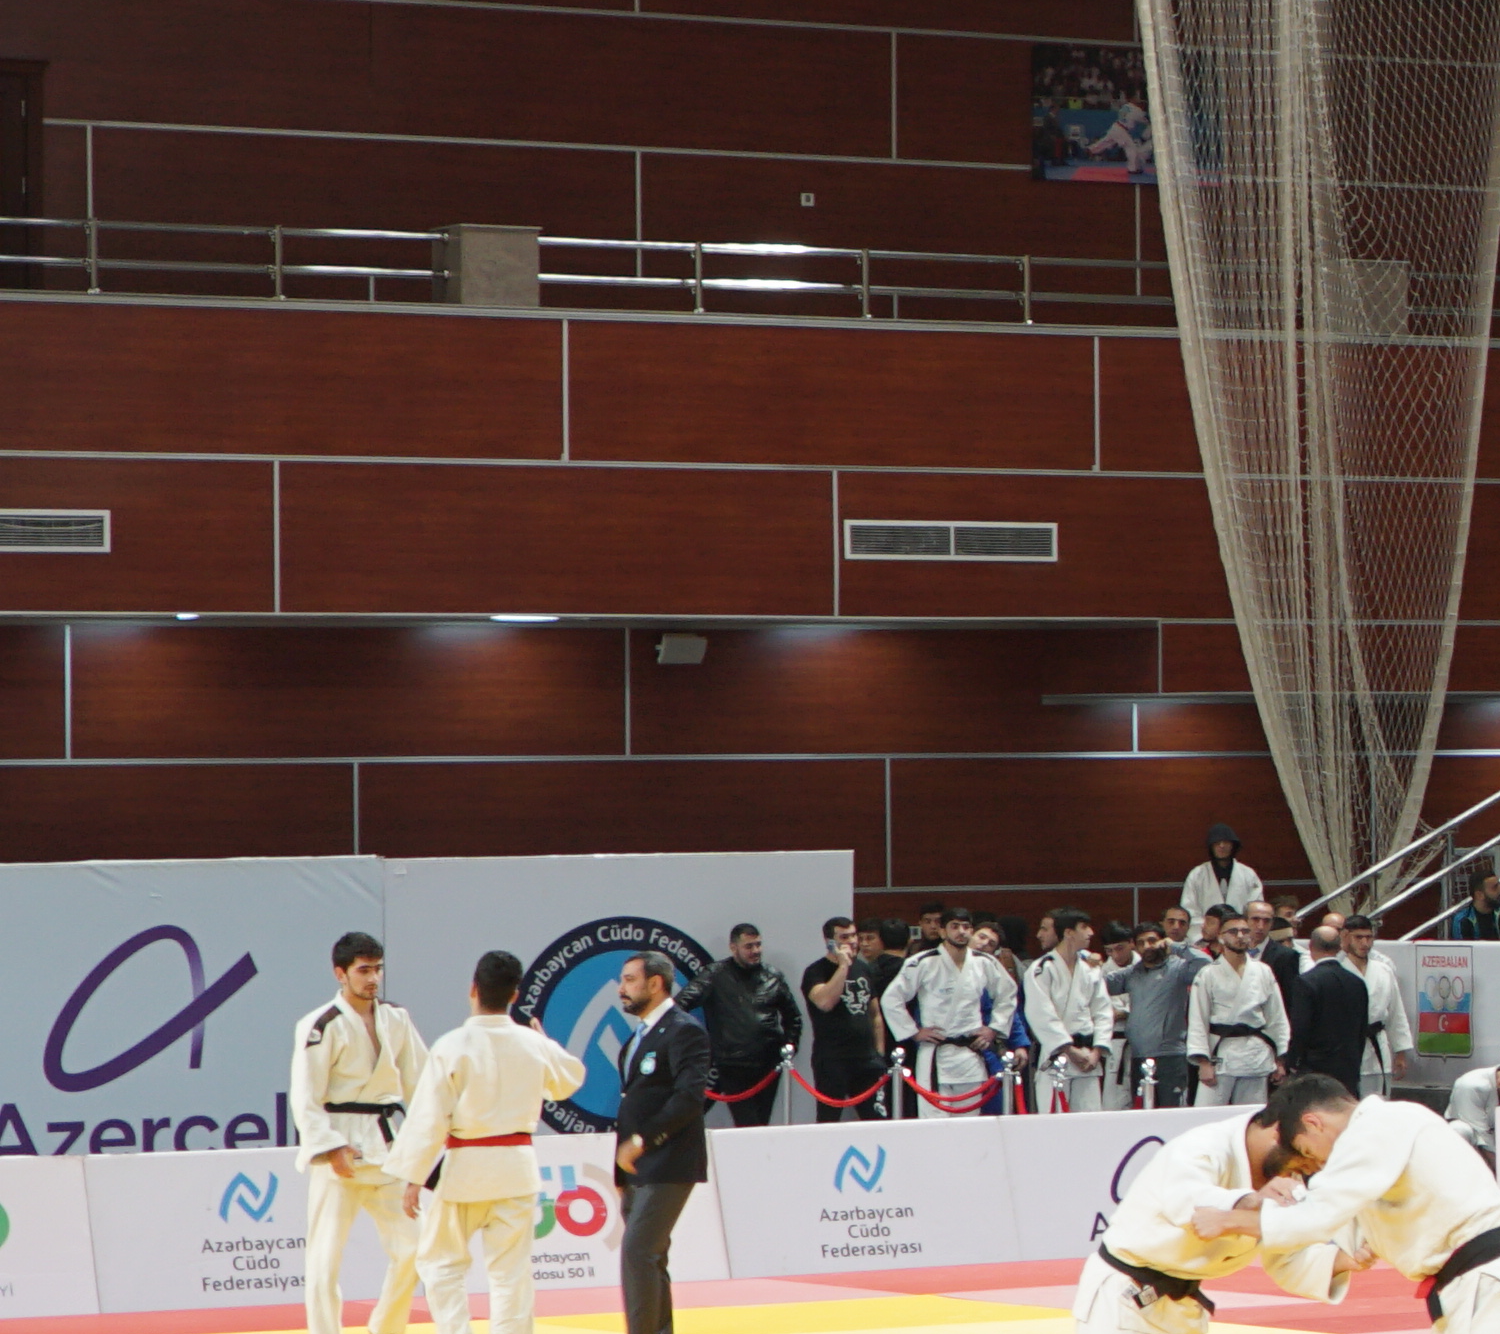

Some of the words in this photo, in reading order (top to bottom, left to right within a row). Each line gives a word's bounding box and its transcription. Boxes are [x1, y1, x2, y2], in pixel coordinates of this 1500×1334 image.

[596, 923, 645, 945] Cüdo
[1421, 954, 1469, 968] AZERBAIJAN
[819, 1203, 915, 1224] Azərbaycan
[847, 1223, 892, 1240] Cüdo
[820, 1241, 922, 1259] Federasiyası
[232, 1253, 281, 1271] Cüdo
[568, 1266, 585, 1280] 50
[201, 1274, 306, 1294] Federasiyas
